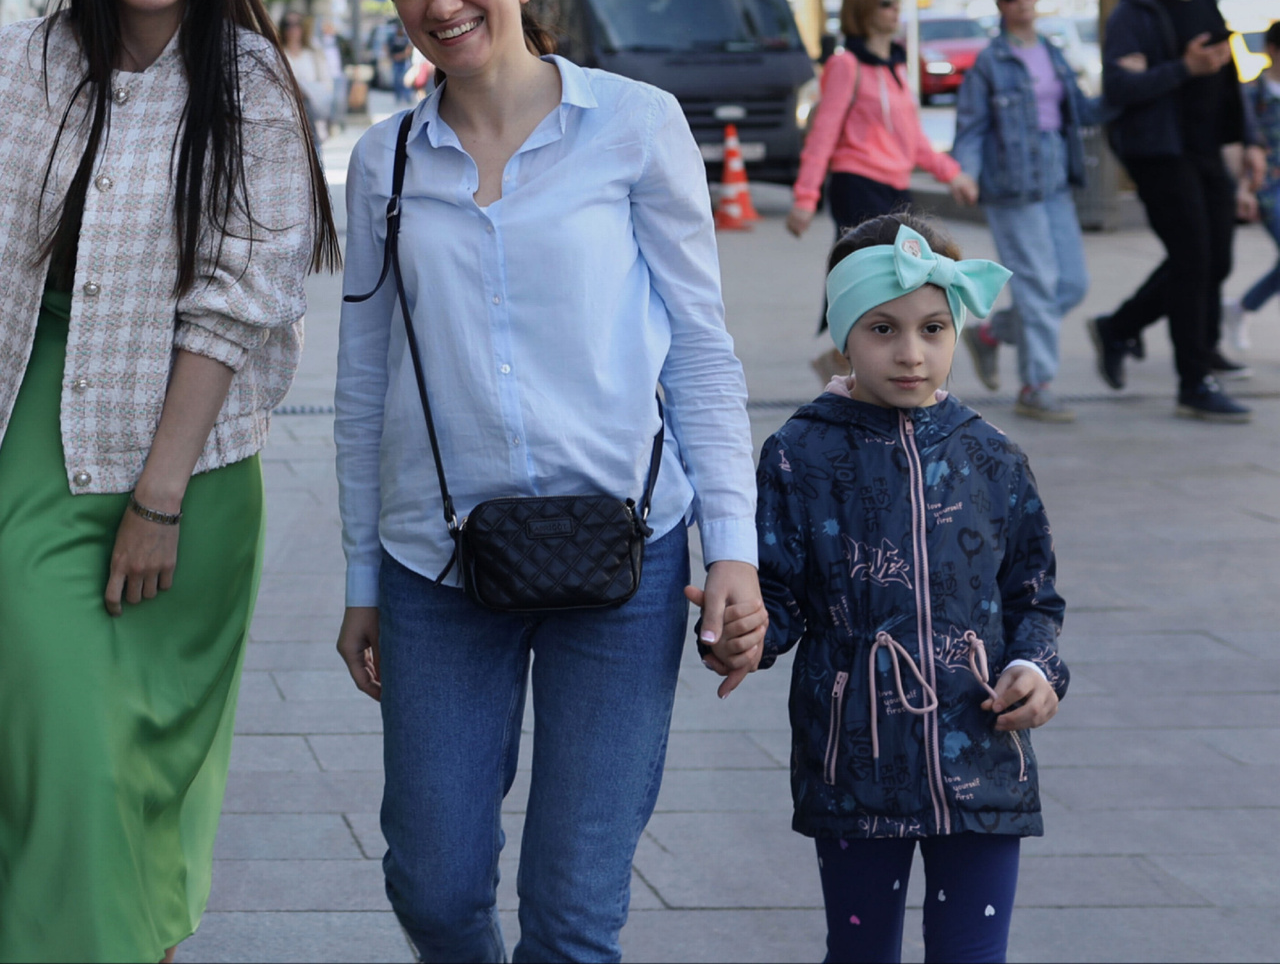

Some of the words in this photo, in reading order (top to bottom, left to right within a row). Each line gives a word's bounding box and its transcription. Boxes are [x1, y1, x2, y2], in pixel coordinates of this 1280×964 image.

[926, 502, 943, 511] love
[933, 501, 963, 519] yourself
[936, 515, 953, 526] first
[943, 774, 962, 784] love
[952, 776, 981, 793] yourself
[955, 790, 975, 801] first
